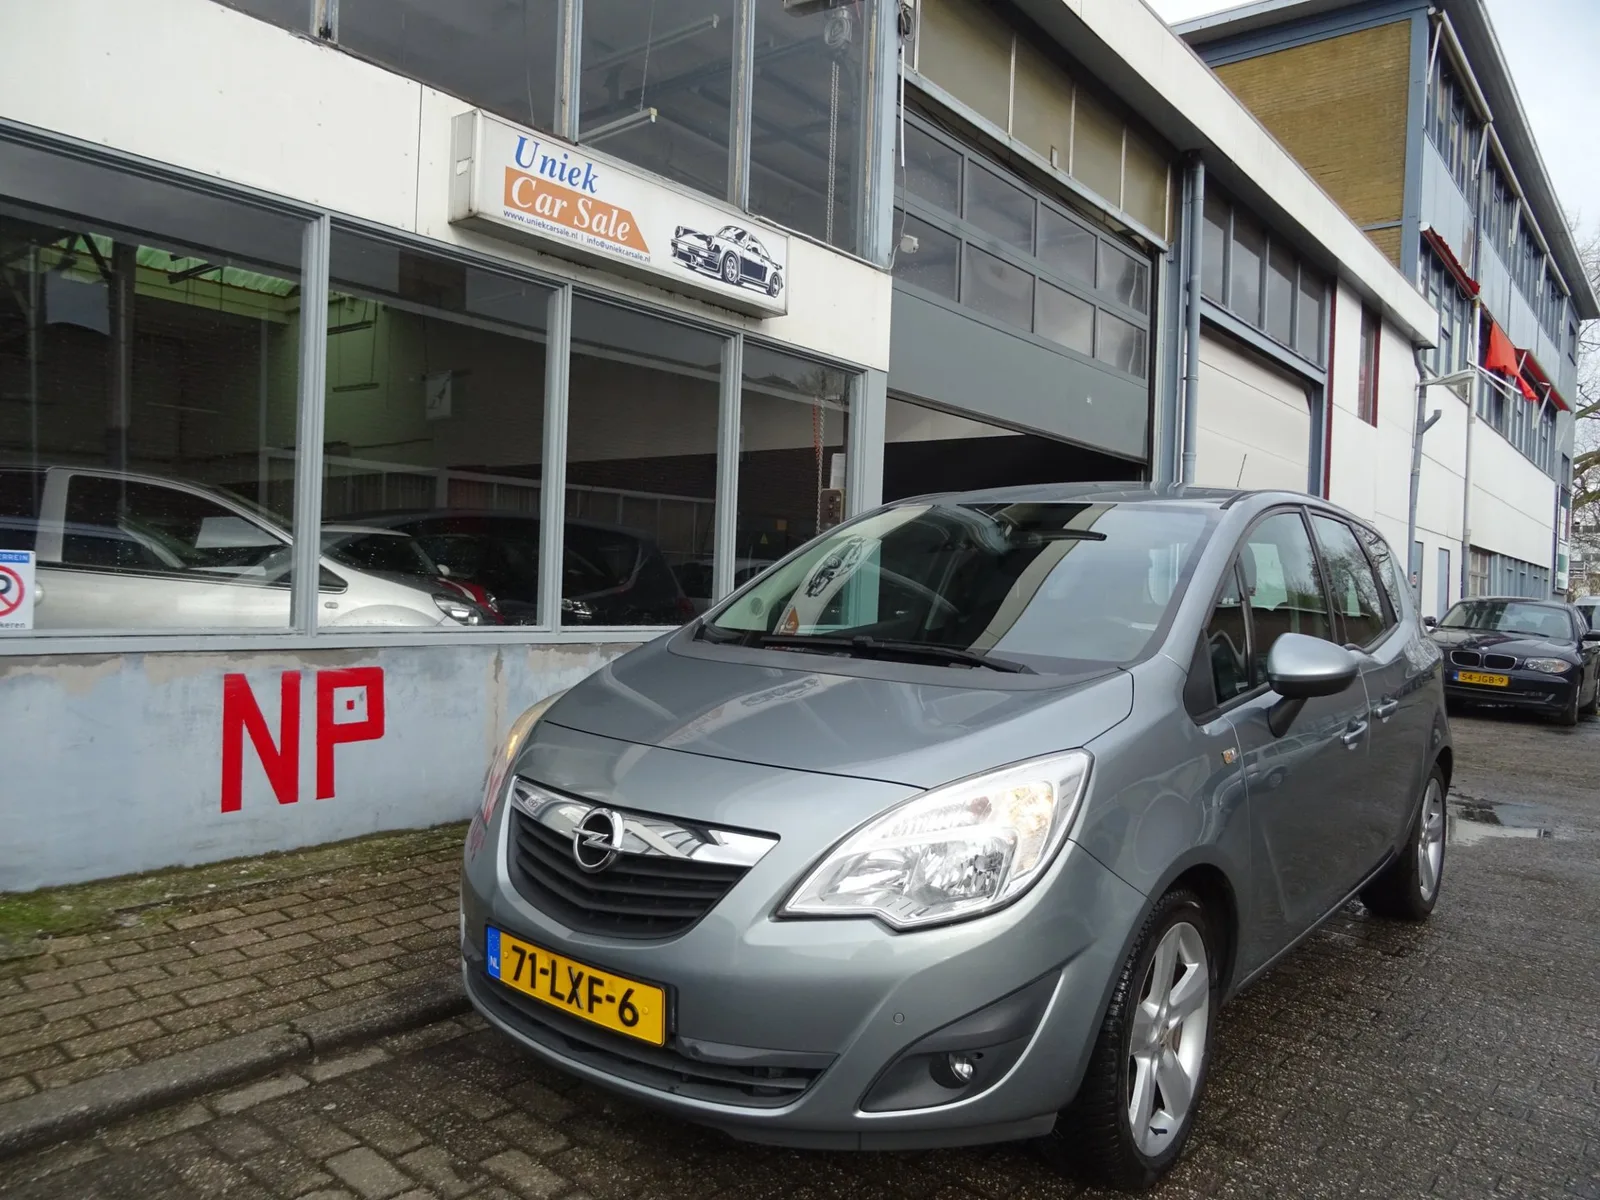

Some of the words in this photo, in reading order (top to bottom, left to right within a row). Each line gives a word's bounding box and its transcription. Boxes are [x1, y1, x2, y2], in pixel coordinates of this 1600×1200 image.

[514, 134, 600, 194] Uniek
[503, 209, 578, 240] www.uniekcarsale.nl
[586, 236, 651, 263] info@uniekcarsale.nl
[511, 176, 568, 218] Car
[573, 197, 631, 242] Sale
[1460, 673, 1505, 684] 54-JGB-9
[220, 665, 385, 814] NP
[489, 955, 500, 970] NL
[511, 943, 640, 1028] 71-LXF-6
